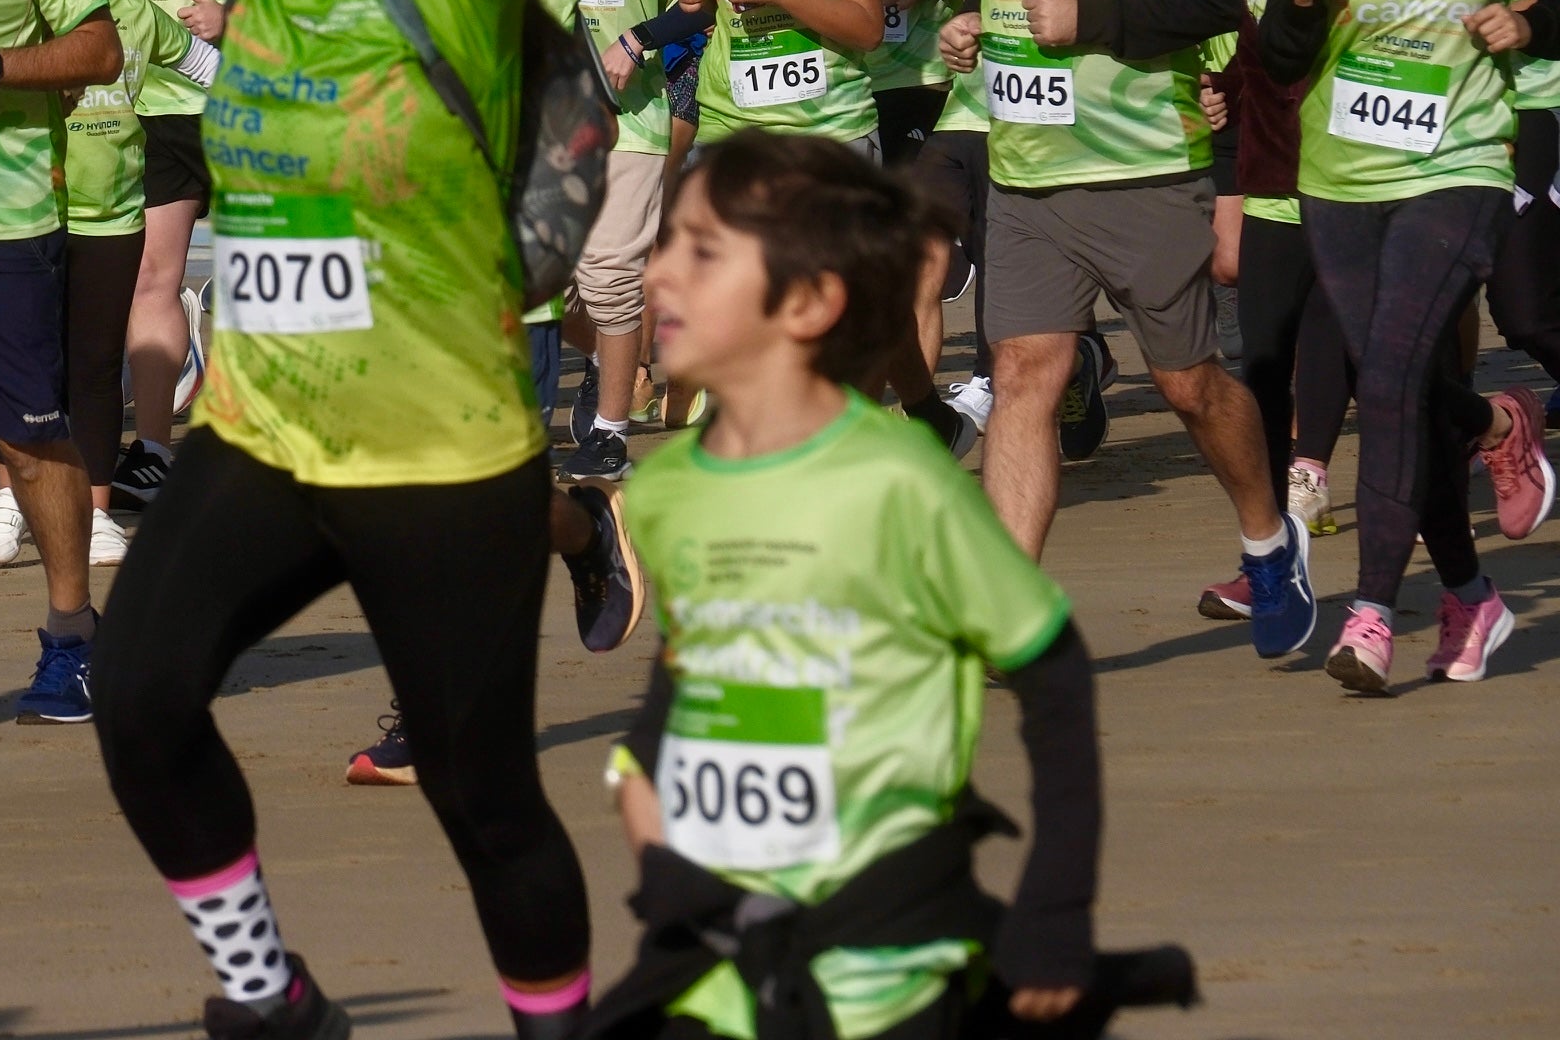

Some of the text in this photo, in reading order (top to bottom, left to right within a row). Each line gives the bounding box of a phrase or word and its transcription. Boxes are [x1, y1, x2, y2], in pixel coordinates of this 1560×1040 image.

[1375, 35, 1435, 52] HYUNDAI
[744, 57, 820, 92] 1765
[992, 70, 1068, 107] 4045
[86, 120, 120, 130] HYUNDAI
[1349, 91, 1438, 134] 4044
[230, 252, 353, 303] 2070
